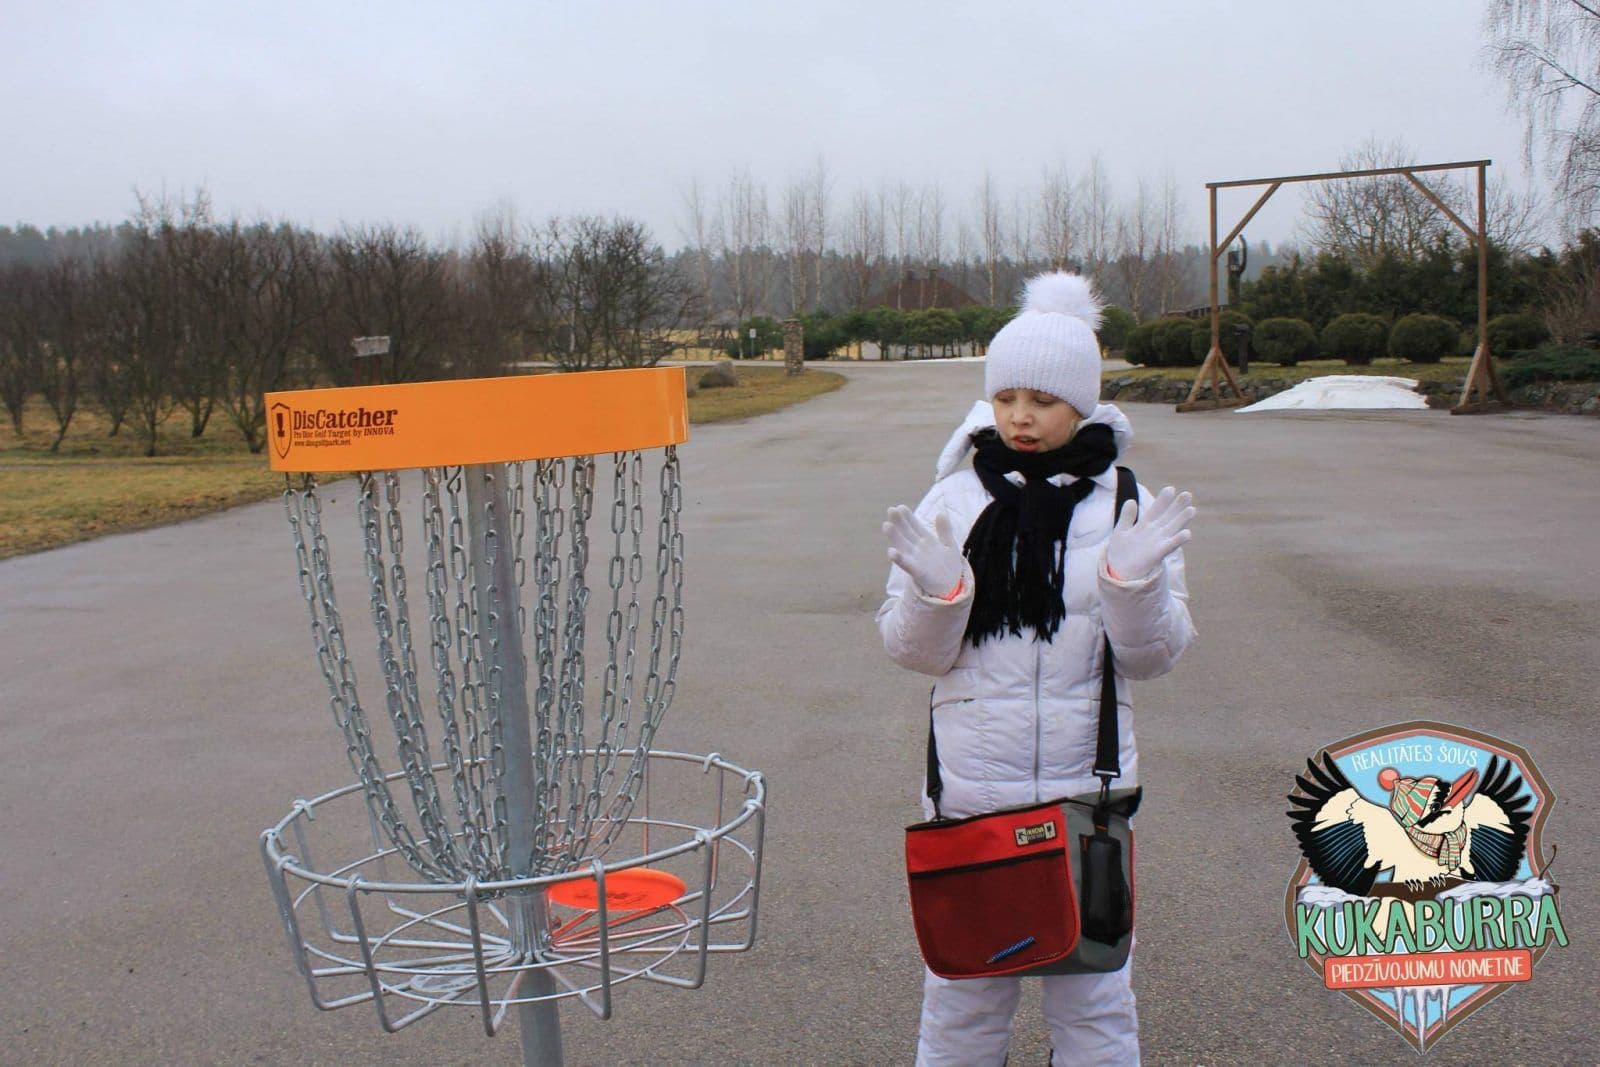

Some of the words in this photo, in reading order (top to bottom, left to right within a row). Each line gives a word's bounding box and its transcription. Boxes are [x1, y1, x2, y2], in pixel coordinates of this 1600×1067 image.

[293, 408, 398, 430] DisCatcher
[315, 429, 326, 438] Golf
[328, 429, 351, 439] Target
[353, 429, 361, 438] by
[364, 427, 394, 436] INNOVA
